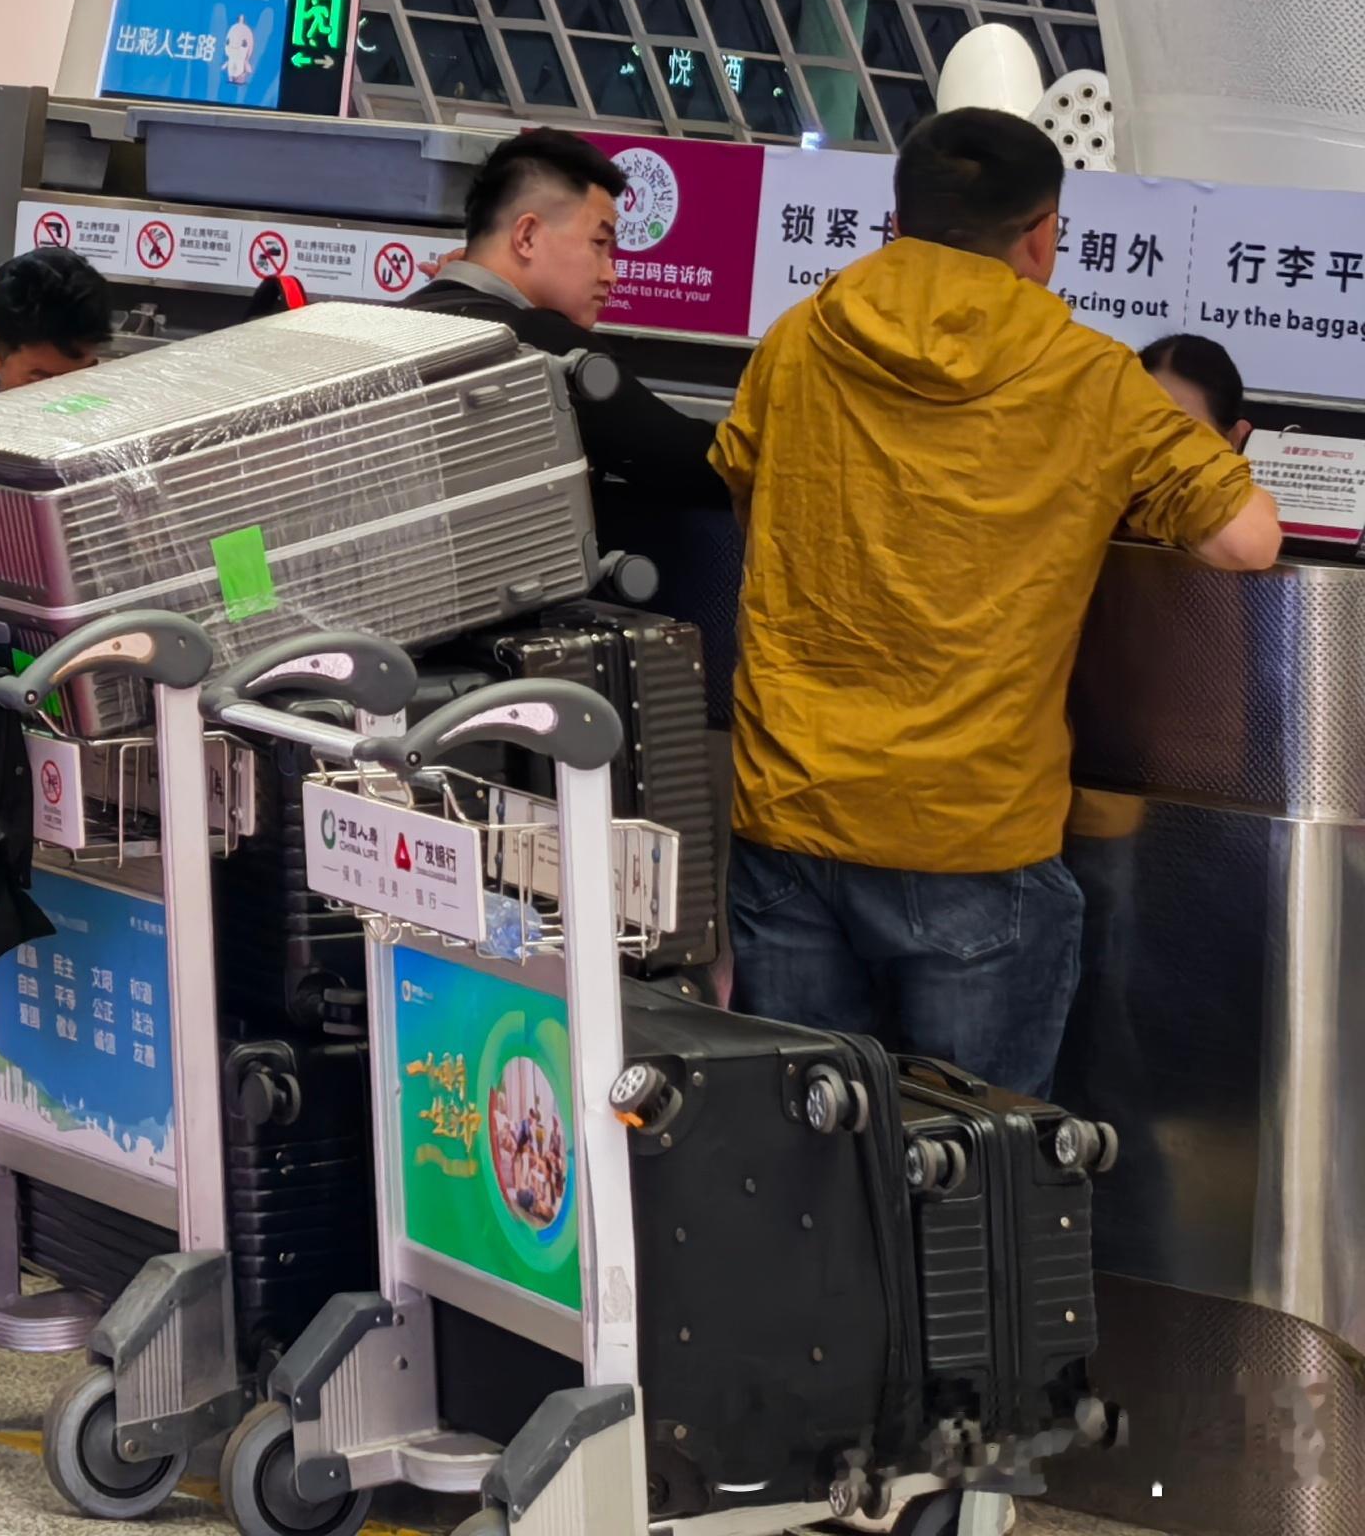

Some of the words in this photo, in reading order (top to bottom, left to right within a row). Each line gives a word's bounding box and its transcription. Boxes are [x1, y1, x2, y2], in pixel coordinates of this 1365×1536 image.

[116, 24, 218, 63] 出彩人生路
[1227, 242, 1364, 293] 行李平
[640, 286, 653, 297] to
[654, 287, 683, 300] track
[685, 290, 712, 303] your
[1132, 297, 1169, 318] out
[1200, 301, 1239, 329] Lay
[1244, 306, 1281, 328] the
